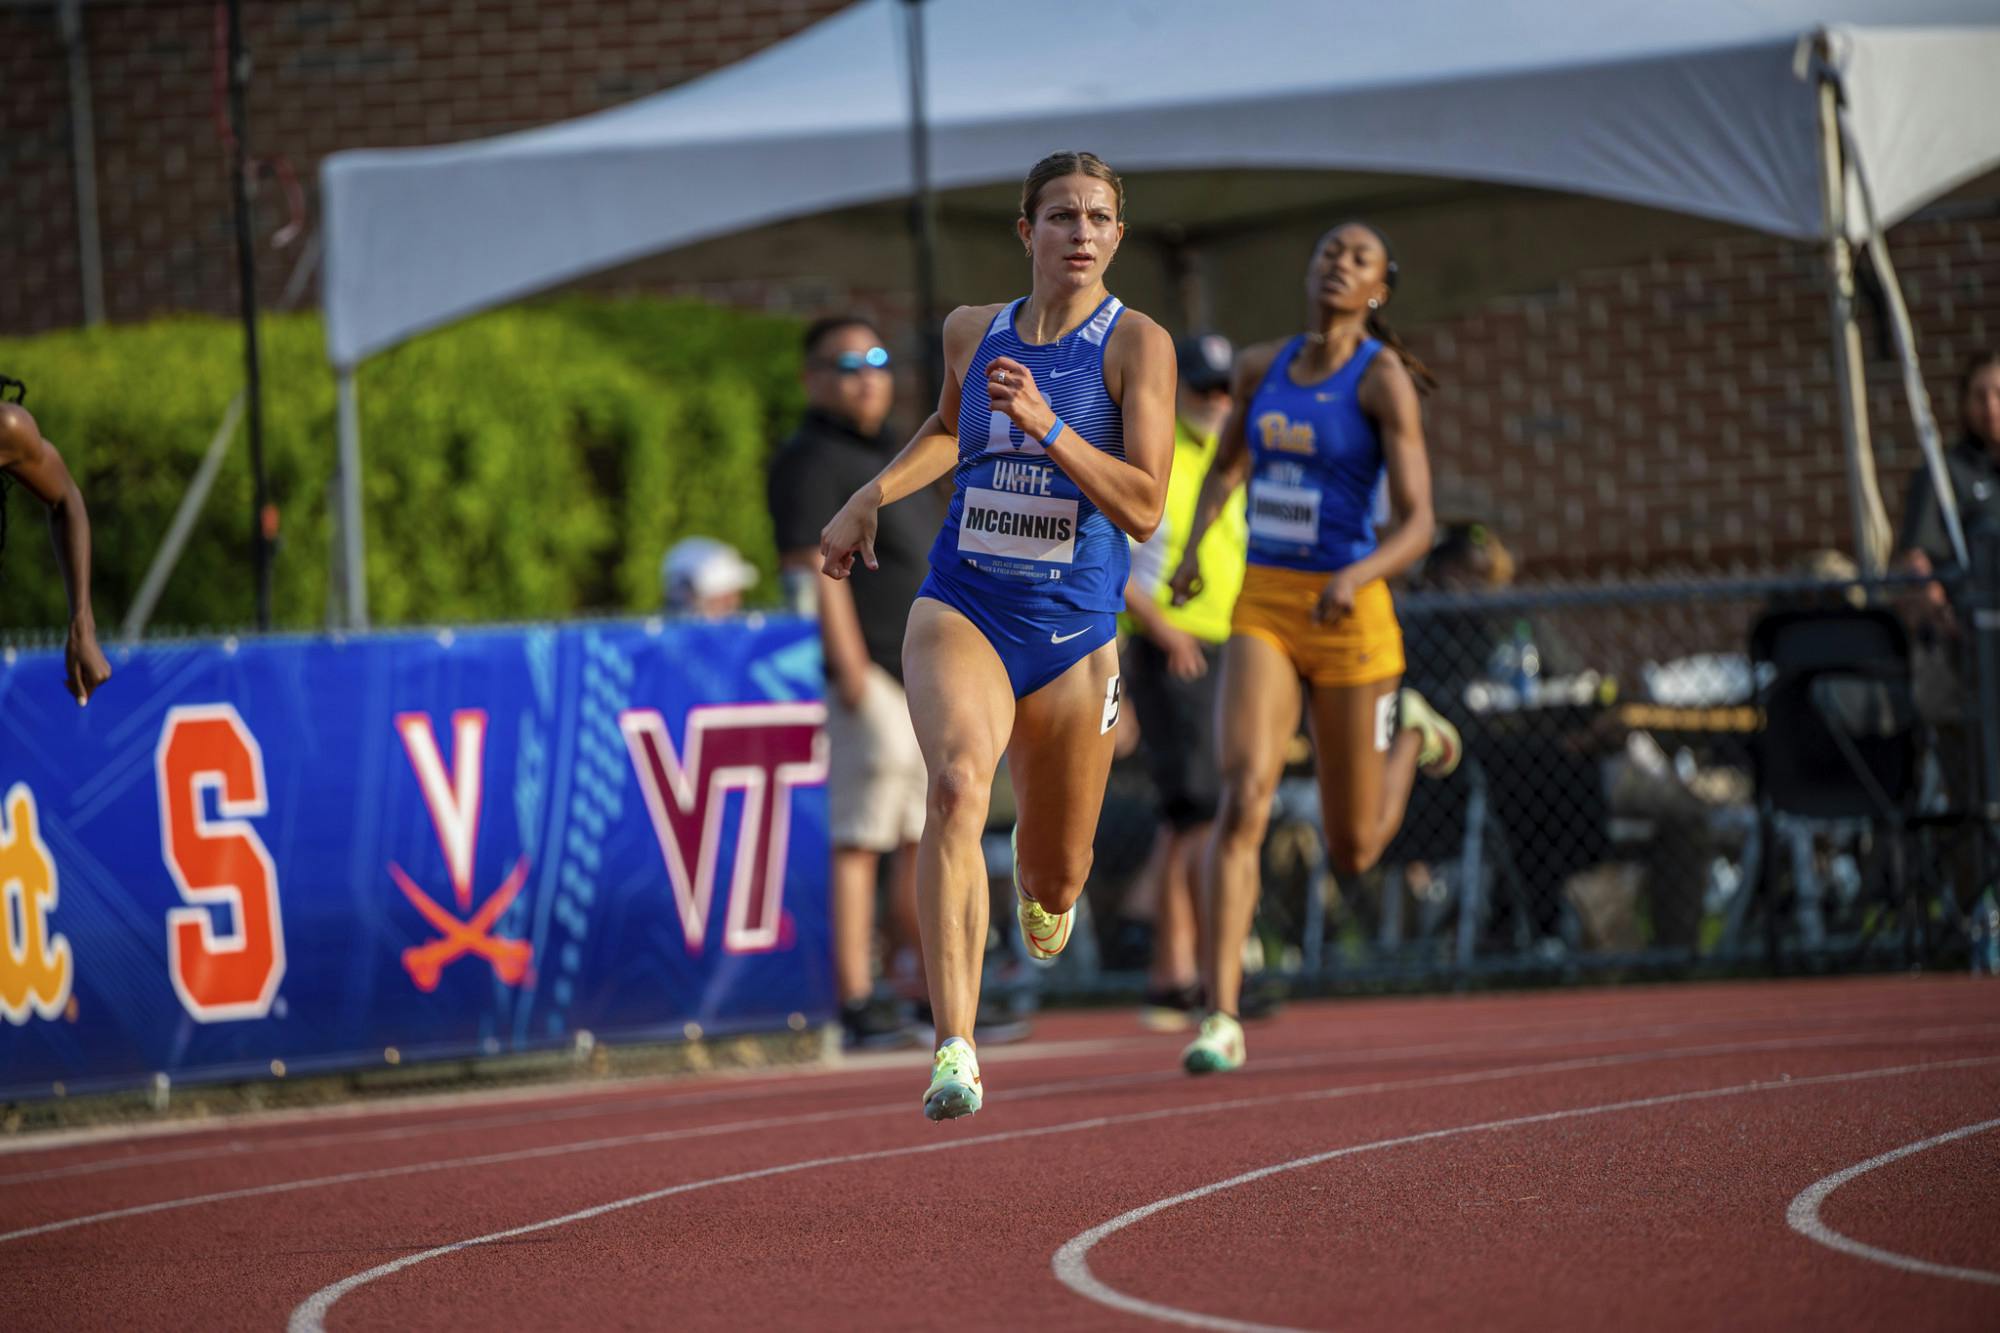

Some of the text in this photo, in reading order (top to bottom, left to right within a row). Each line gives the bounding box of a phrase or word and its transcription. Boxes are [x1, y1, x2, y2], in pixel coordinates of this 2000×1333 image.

[965, 506, 1071, 541] MCGINNIS
[992, 460, 1054, 496] UNITE
[156, 703, 287, 1023] S
[393, 708, 487, 912] V
[618, 701, 832, 955] VT
